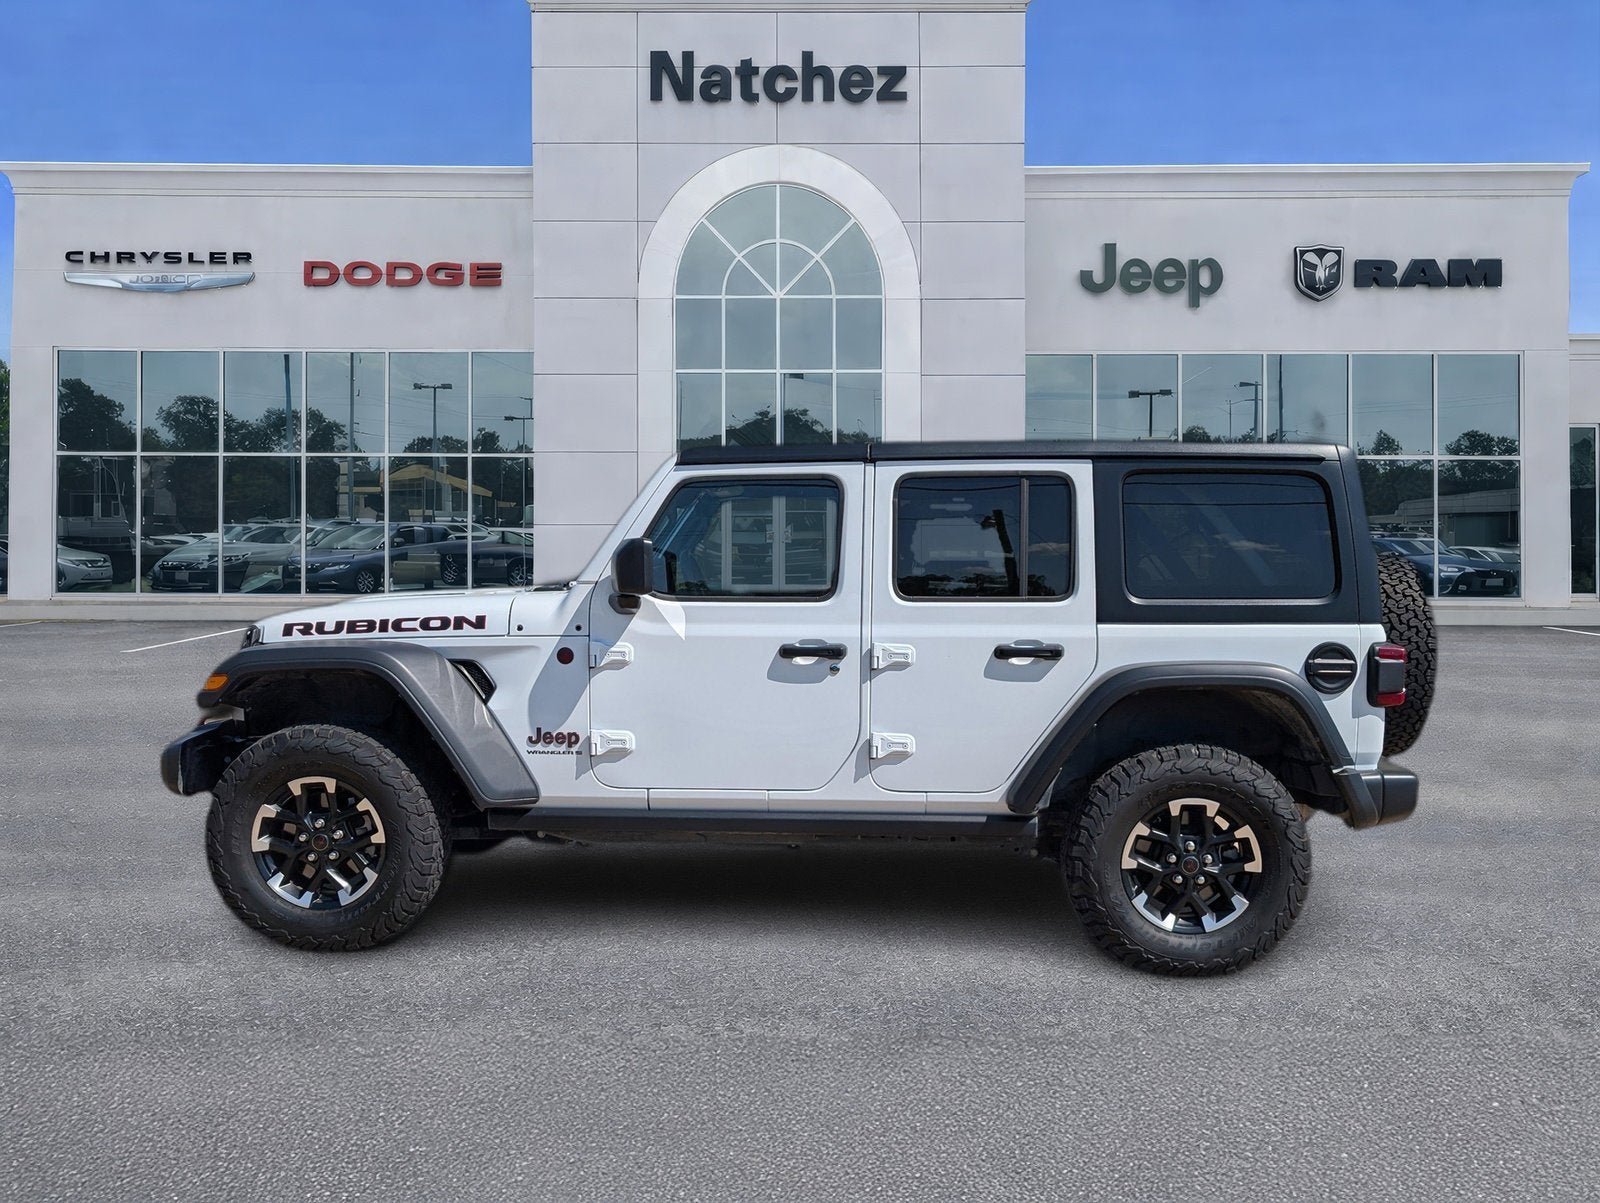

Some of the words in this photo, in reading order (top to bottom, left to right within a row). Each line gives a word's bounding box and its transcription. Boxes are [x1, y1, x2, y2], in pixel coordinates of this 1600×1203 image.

[650, 50, 908, 103] Natchez
[65, 250, 253, 264] CHRYSLER
[304, 261, 502, 287] DODGE
[1080, 243, 1224, 308] Jeep
[1354, 258, 1503, 288] RAM
[282, 615, 487, 637] RUBICON
[527, 727, 580, 748] Jeep
